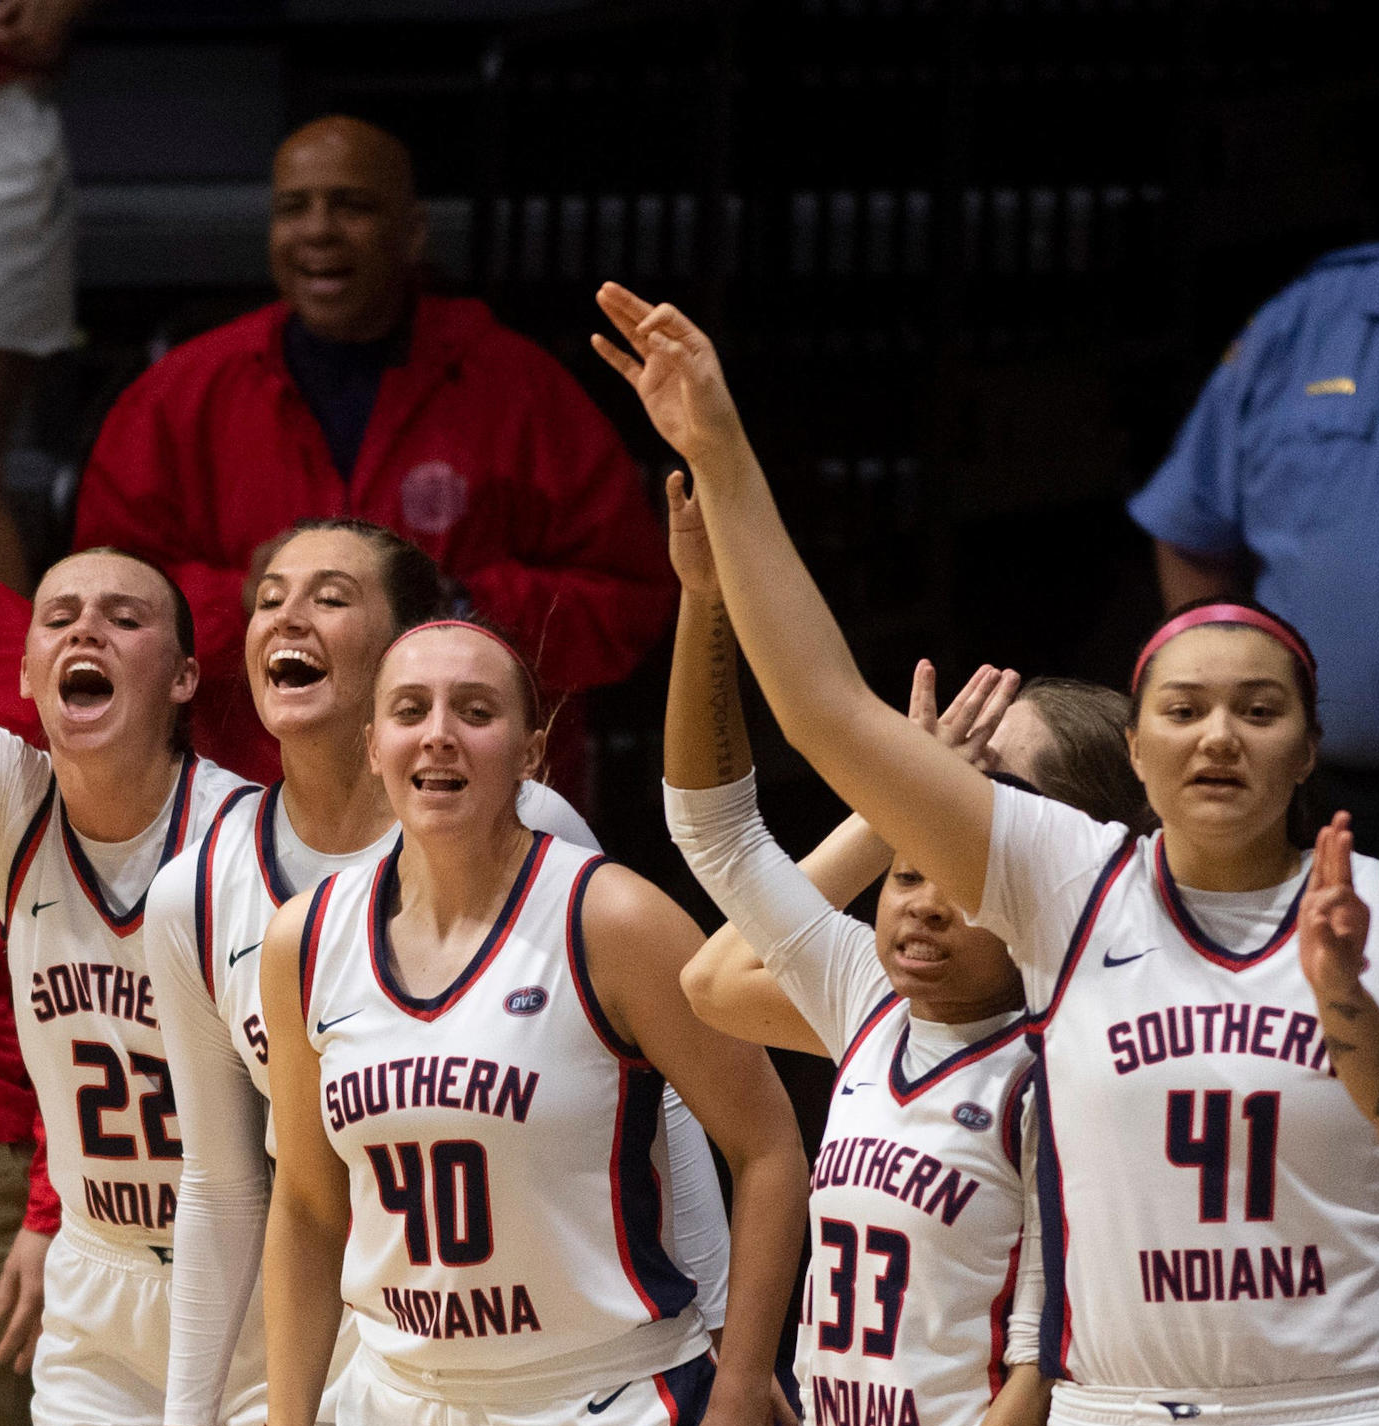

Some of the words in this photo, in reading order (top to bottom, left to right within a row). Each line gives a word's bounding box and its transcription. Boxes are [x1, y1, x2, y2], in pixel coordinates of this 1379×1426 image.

[30, 962, 161, 1031] SOUTHE
[72, 1039, 184, 1161] 22
[325, 1056, 540, 1133] SOUTHERN
[1165, 1089, 1281, 1224] 41
[83, 1176, 177, 1229] INDIA
[363, 1139, 494, 1268] 40
[381, 1284, 542, 1339] INDIANA
[818, 1216, 910, 1360] 33
[1139, 1245, 1327, 1303] INDIANA
